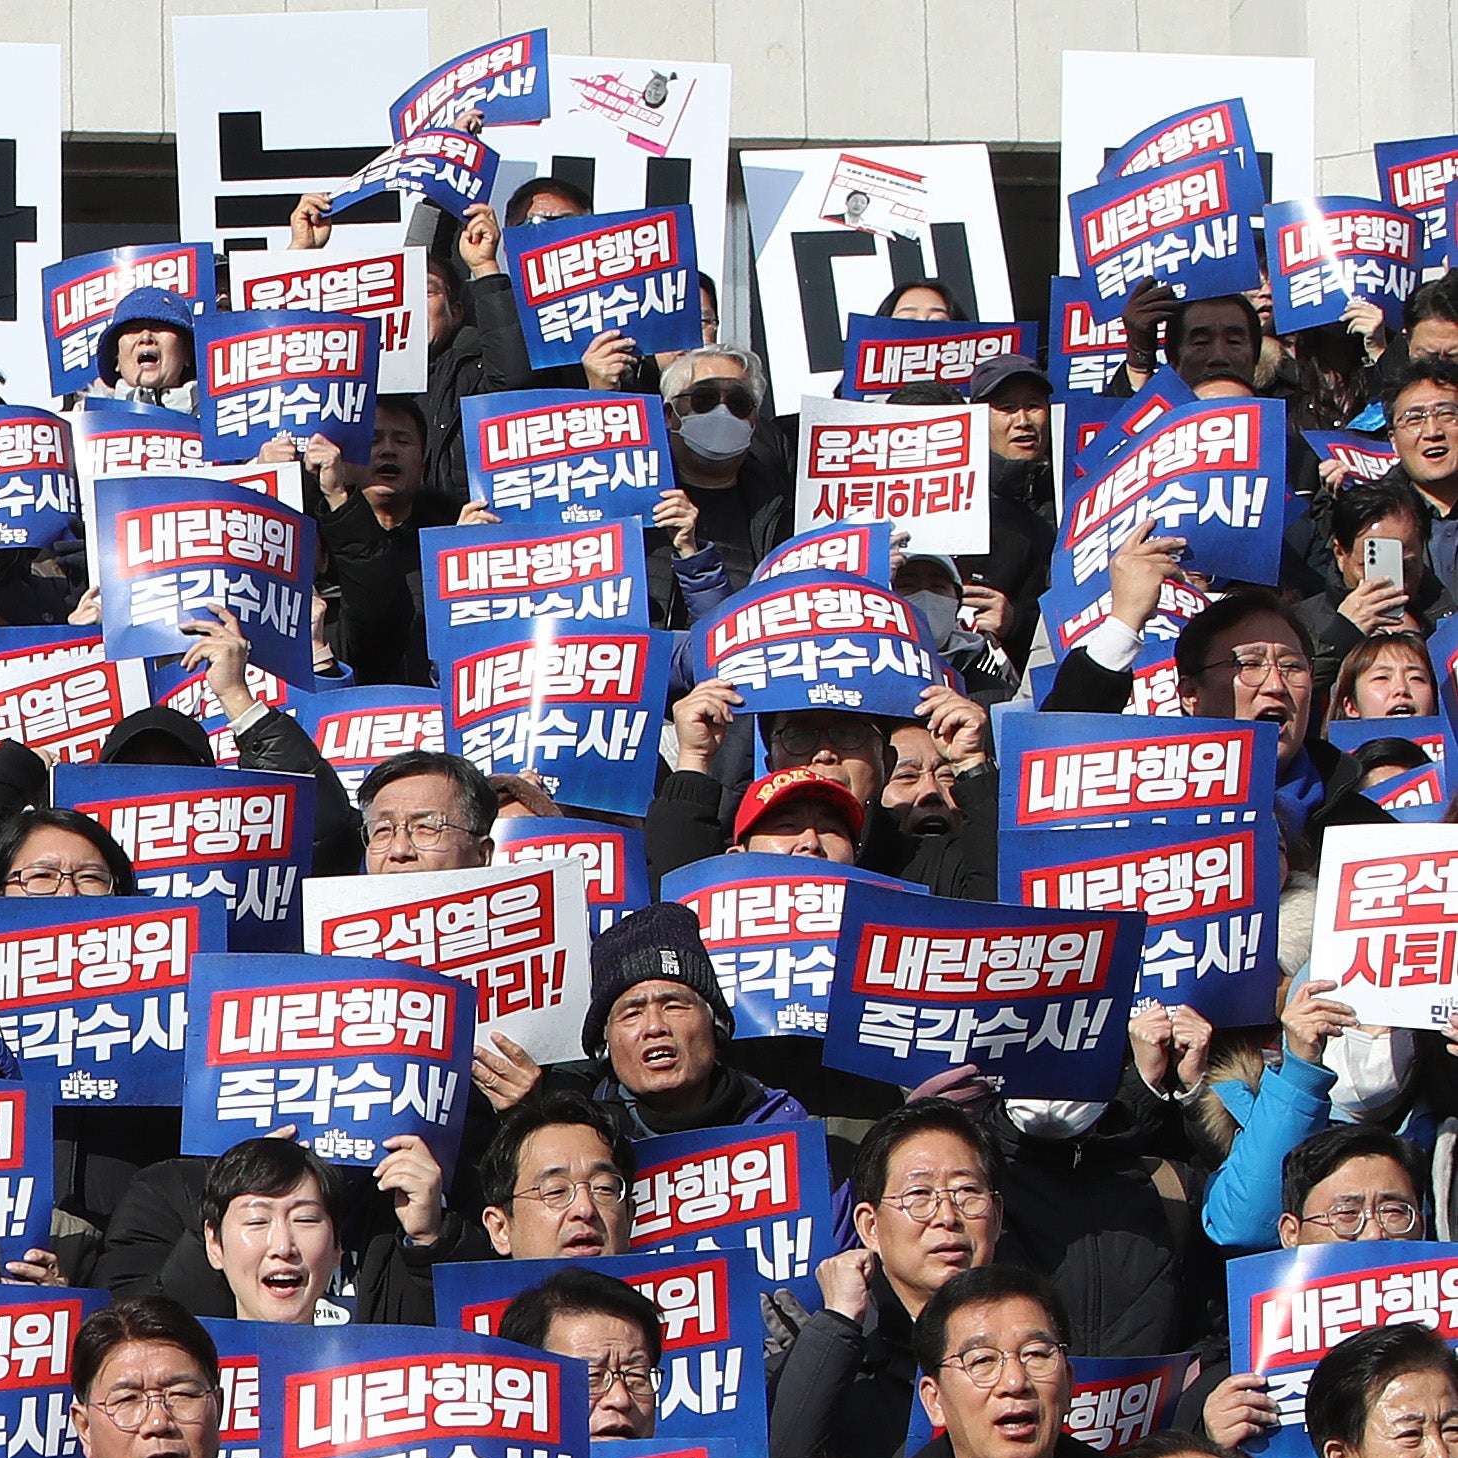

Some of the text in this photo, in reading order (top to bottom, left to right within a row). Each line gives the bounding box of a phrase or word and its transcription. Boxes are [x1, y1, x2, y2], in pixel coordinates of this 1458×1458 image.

[1086, 170, 1221, 254] 내란행위
[526, 220, 671, 297] 내란행위
[538, 277, 686, 347] 즉각수사!
[213, 326, 358, 389] 내란행위
[215, 380, 364, 436] 즉각수사!
[486, 403, 641, 464] 내란행위
[815, 419, 964, 471] 윤석열은
[1076, 412, 1251, 528] 내란행위
[491, 460, 661, 510] 즉각수사!
[813, 476, 976, 525] 사퇴하라!
[124, 505, 297, 577] 내란행위
[446, 531, 617, 594] 내란행위
[714, 594, 914, 653] 내란행위
[458, 641, 638, 712] 내란행위
[716, 641, 932, 690] 즉각수사!
[1028, 740, 1242, 815] 내란행위
[865, 930, 1100, 993] 내란행위
[219, 983, 446, 1054] 내란행위
[858, 999, 1113, 1064] 즉각수사!
[60, 1076, 118, 1100] 민주당
[216, 1067, 458, 1128] 즉각수사!
[315, 1137, 376, 1160] 민주당
[298, 1366, 548, 1450] 내란행위
